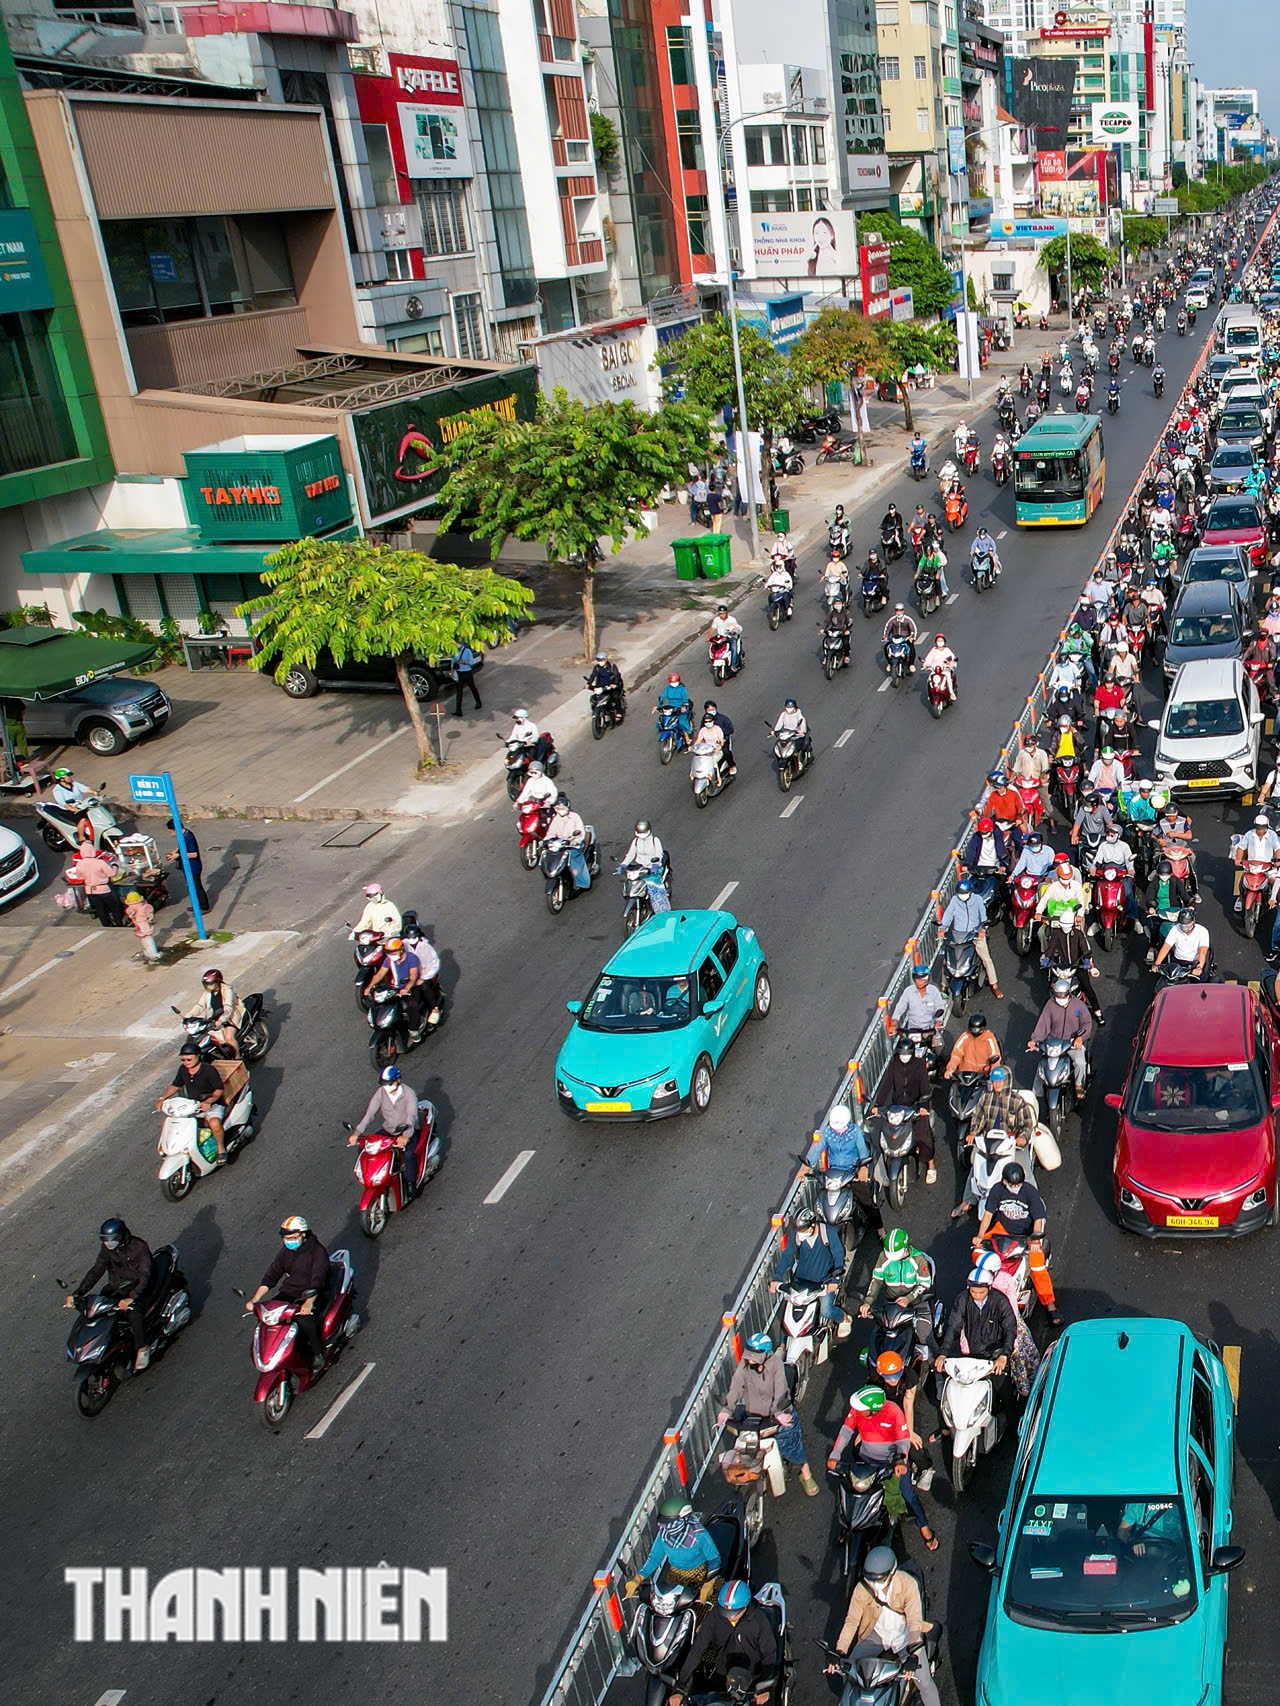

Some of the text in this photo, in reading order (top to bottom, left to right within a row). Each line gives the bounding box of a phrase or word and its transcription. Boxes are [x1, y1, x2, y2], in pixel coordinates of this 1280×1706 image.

[1068, 13, 1098, 22] VNO
[7, 241, 26, 254] NAM
[781, 246, 805, 255] PHÁP
